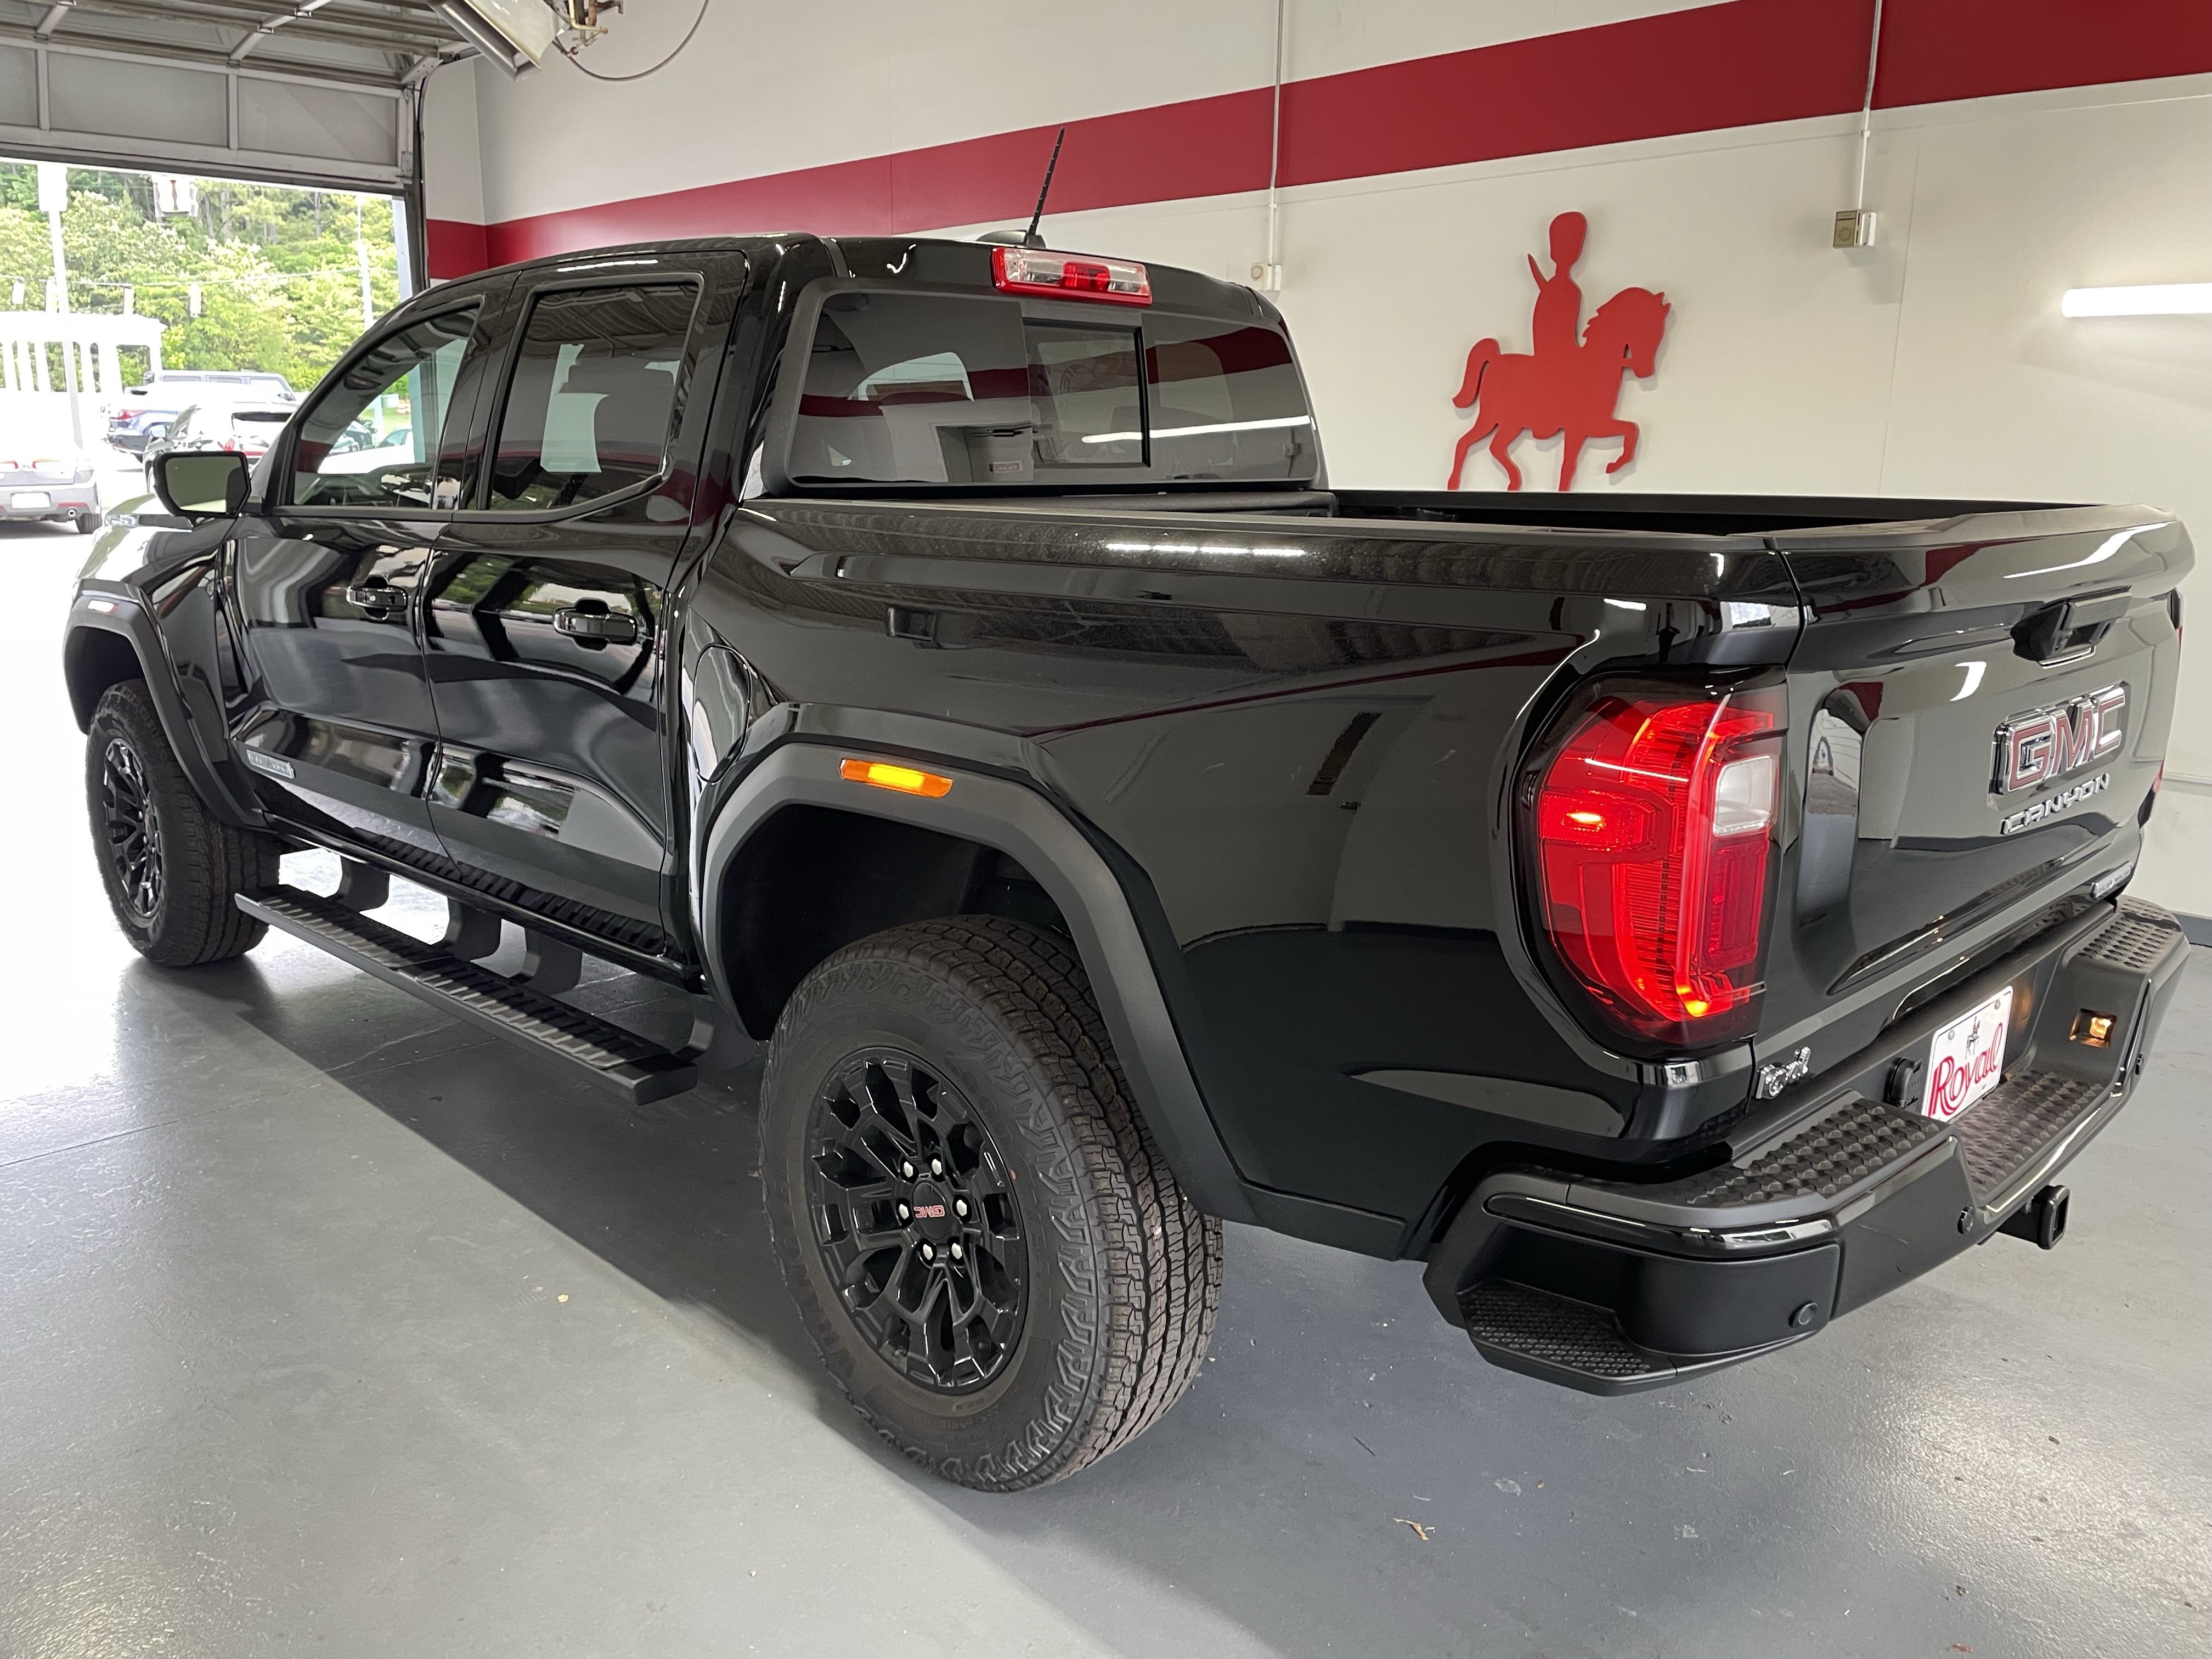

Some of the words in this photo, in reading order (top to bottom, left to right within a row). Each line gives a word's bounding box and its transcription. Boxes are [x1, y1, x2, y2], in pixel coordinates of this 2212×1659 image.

[1991, 685, 2127, 795] GMC
[2000, 773, 2111, 835] CANYON
[1927, 1022, 2004, 1118] Royal
[913, 1205, 945, 1218] GMC
